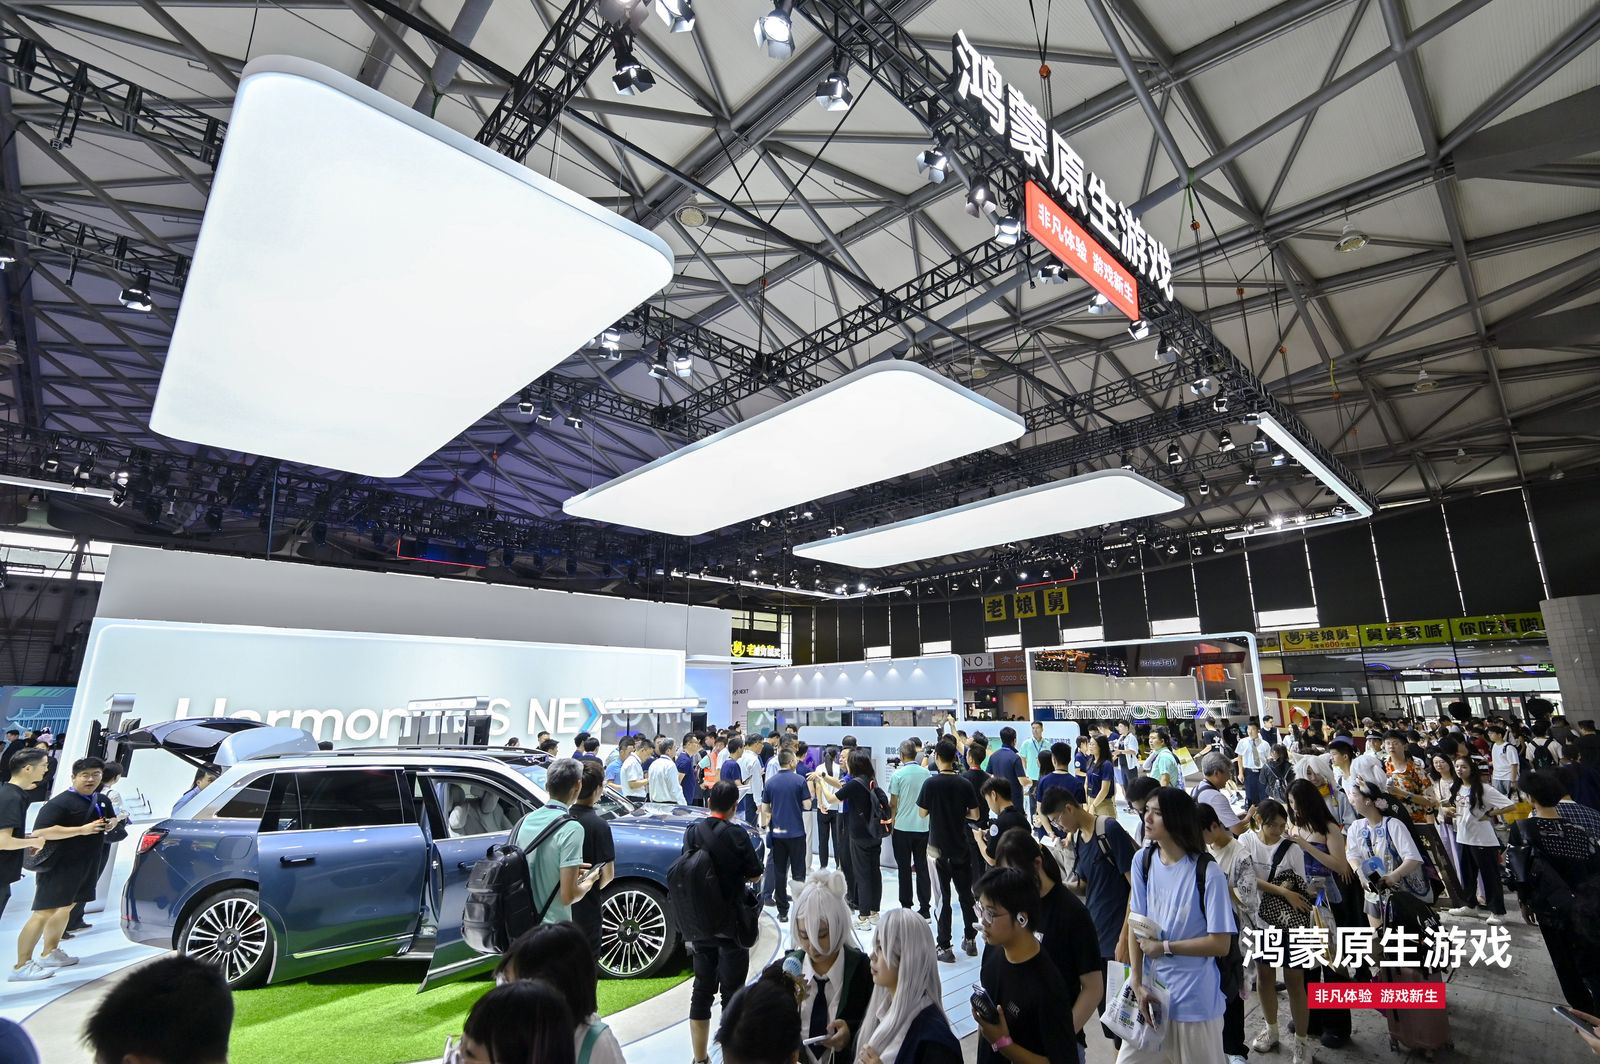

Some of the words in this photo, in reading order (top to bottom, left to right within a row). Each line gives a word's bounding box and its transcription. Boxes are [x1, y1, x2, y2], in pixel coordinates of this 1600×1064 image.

[956, 29, 1174, 301] 鸿蒙原生游戏
[1038, 203, 1088, 264] 非凡体验
[1092, 251, 1134, 305] 游戏新生
[987, 591, 1065, 617] 老娘舅
[1305, 628, 1350, 642] 老娘舅
[1458, 617, 1544, 637] 你吃饭啦
[1054, 702, 1160, 722] HarmonyOS
[1165, 699, 1230, 719] NEXT
